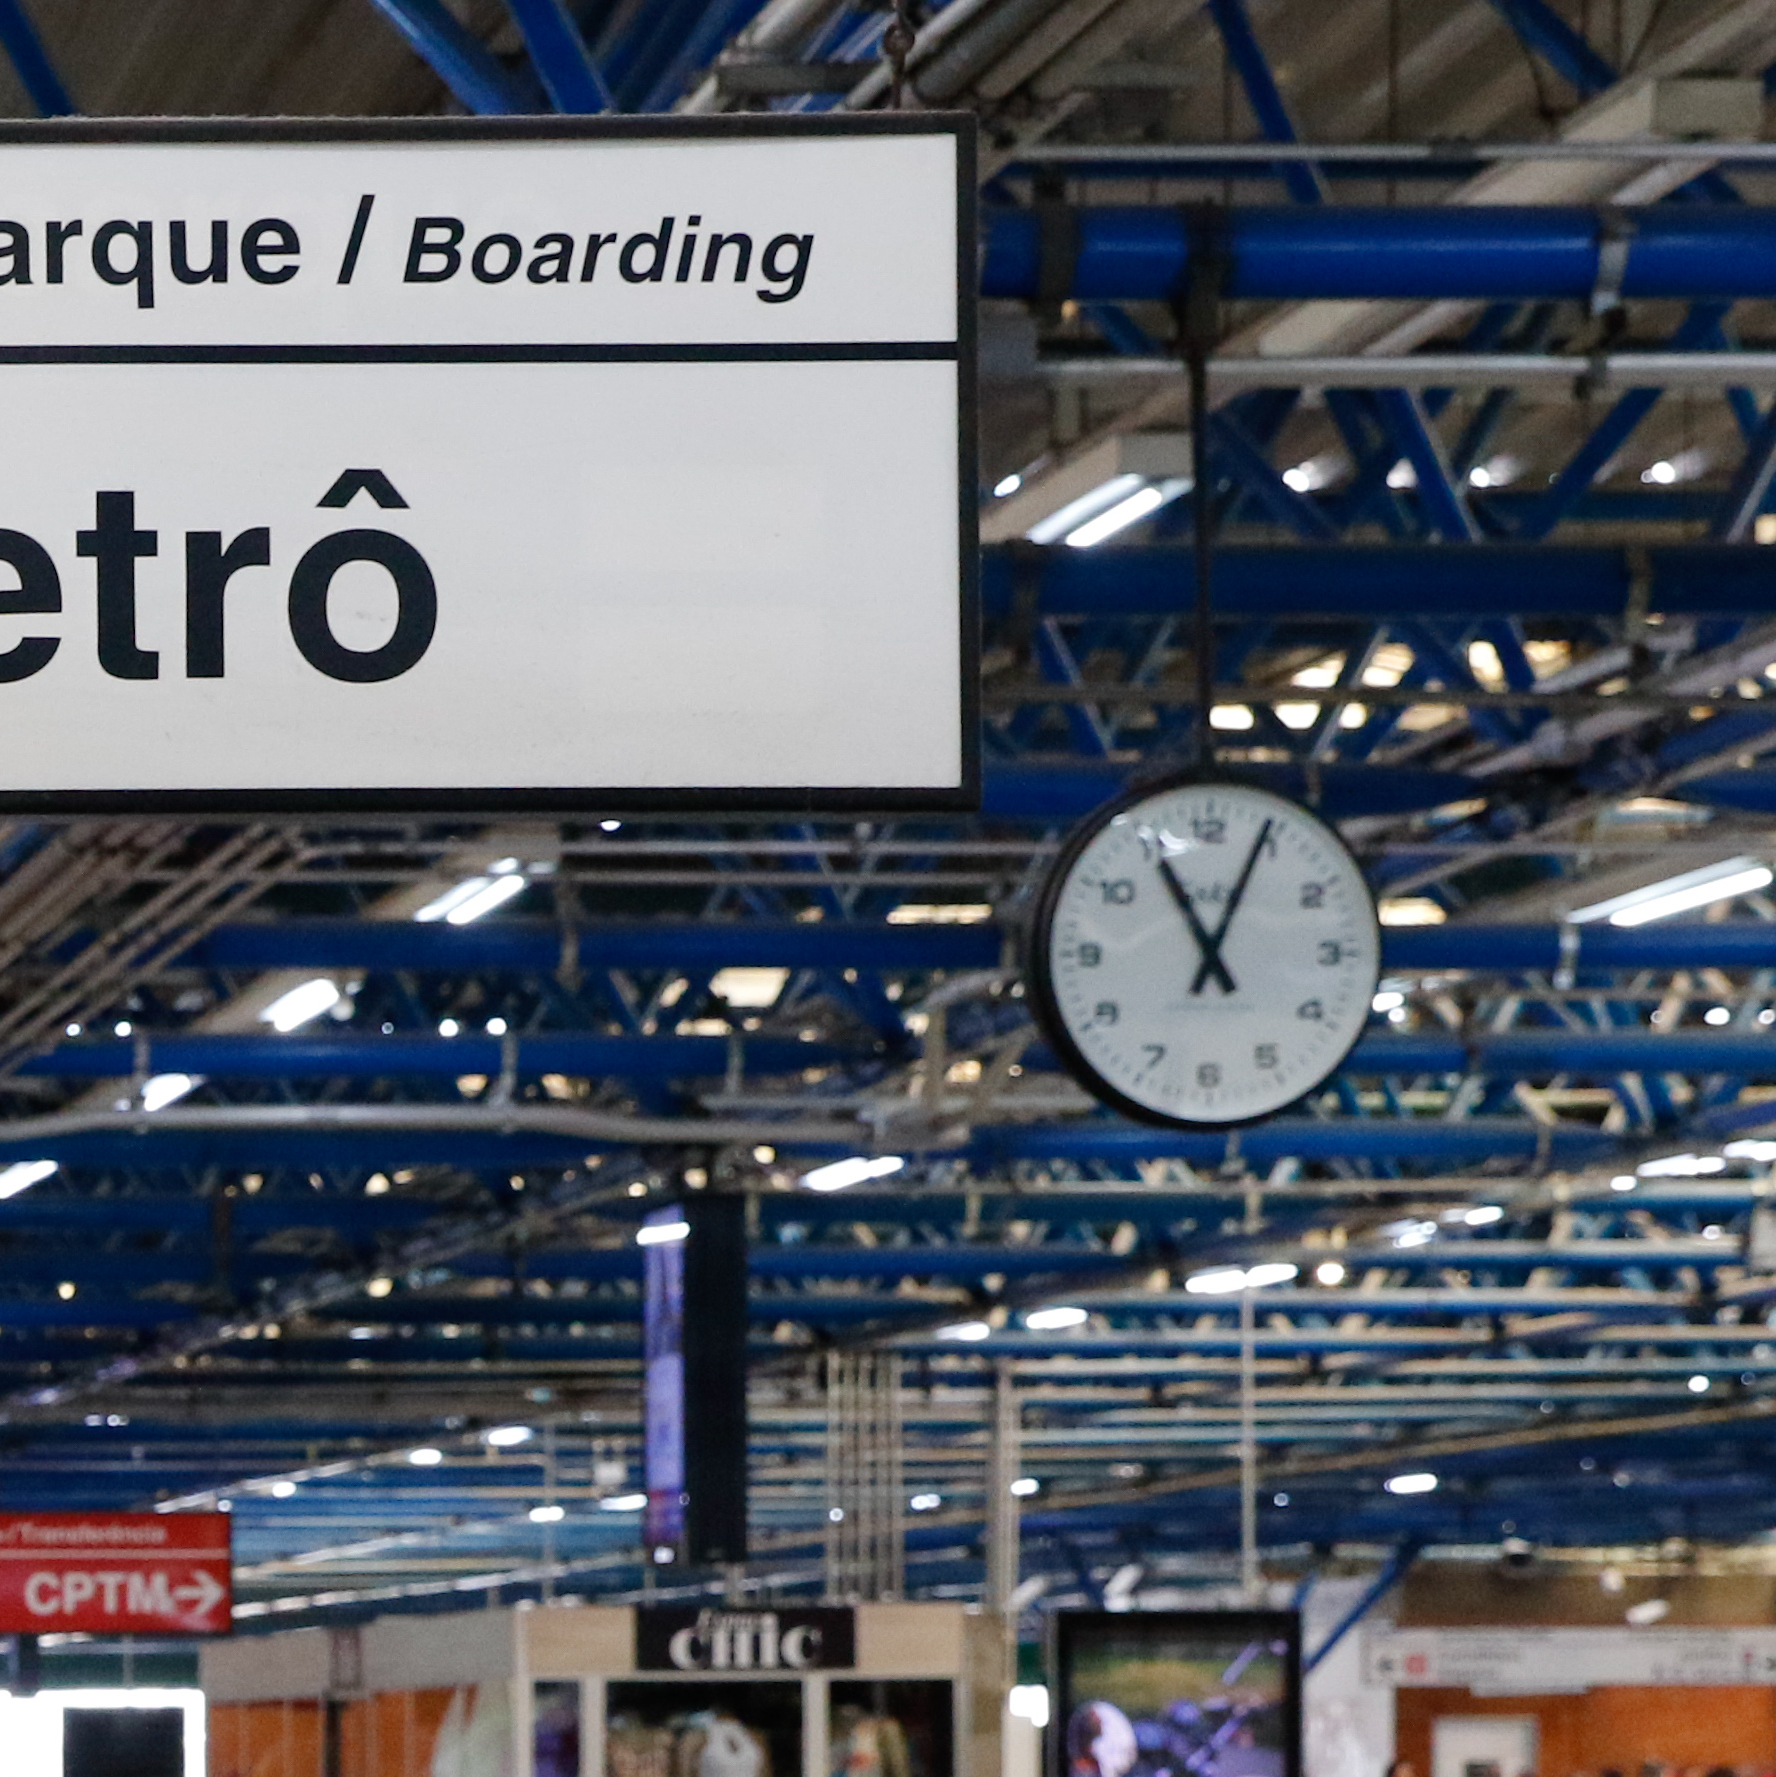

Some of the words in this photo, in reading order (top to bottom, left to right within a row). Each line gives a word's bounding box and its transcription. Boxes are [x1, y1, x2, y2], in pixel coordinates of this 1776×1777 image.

[338, 197, 376, 285] /
[400, 214, 815, 305] Boarding
[1317, 940, 1341, 967] 3
[1141, 1043, 1167, 1069] 7
[1195, 1062, 1221, 1089] 6
[24, 1570, 170, 1616] CPTM
